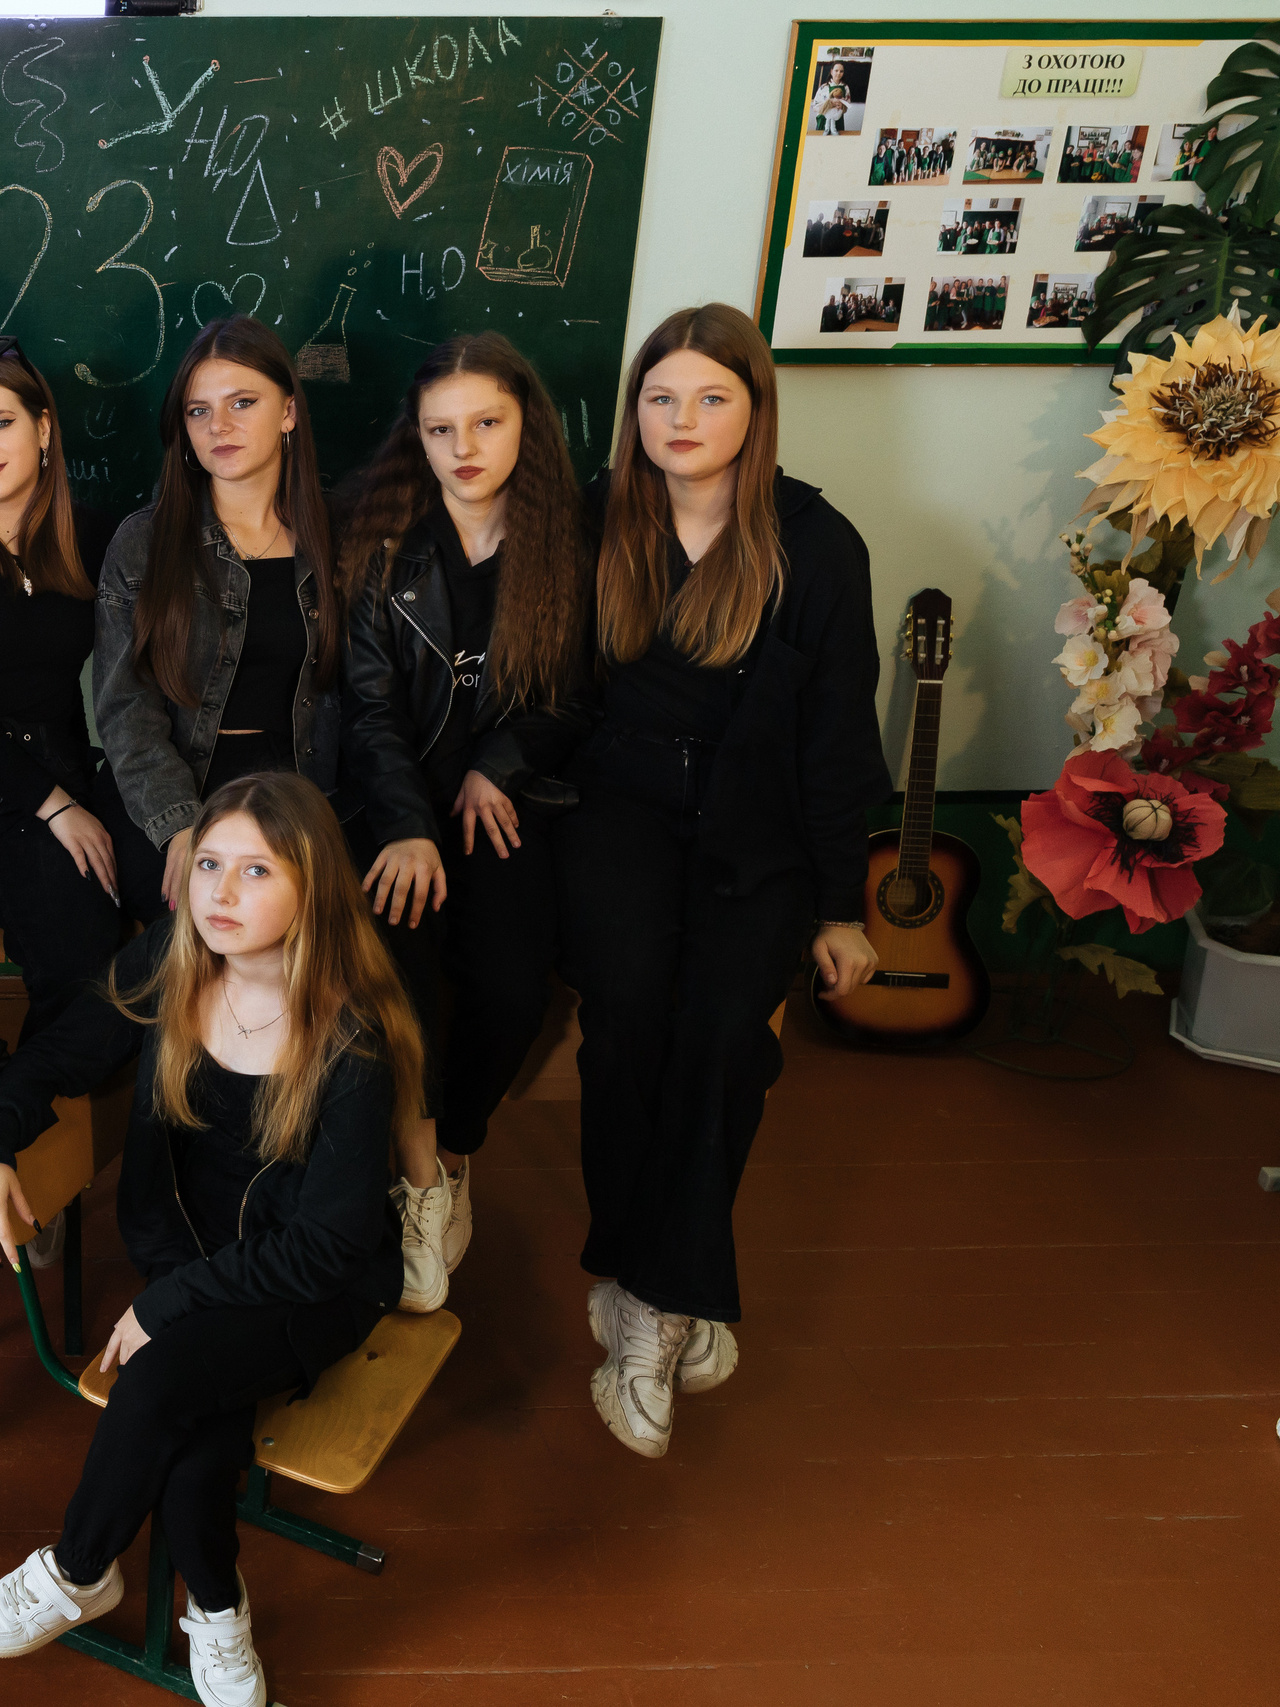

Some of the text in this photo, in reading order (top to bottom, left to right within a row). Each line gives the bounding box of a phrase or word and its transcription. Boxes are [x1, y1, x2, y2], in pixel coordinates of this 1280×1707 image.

[1022, 53, 1125, 70] З ОХОТОЮ
[1012, 78, 1124, 97] ДО ПРАЦІ!!!
